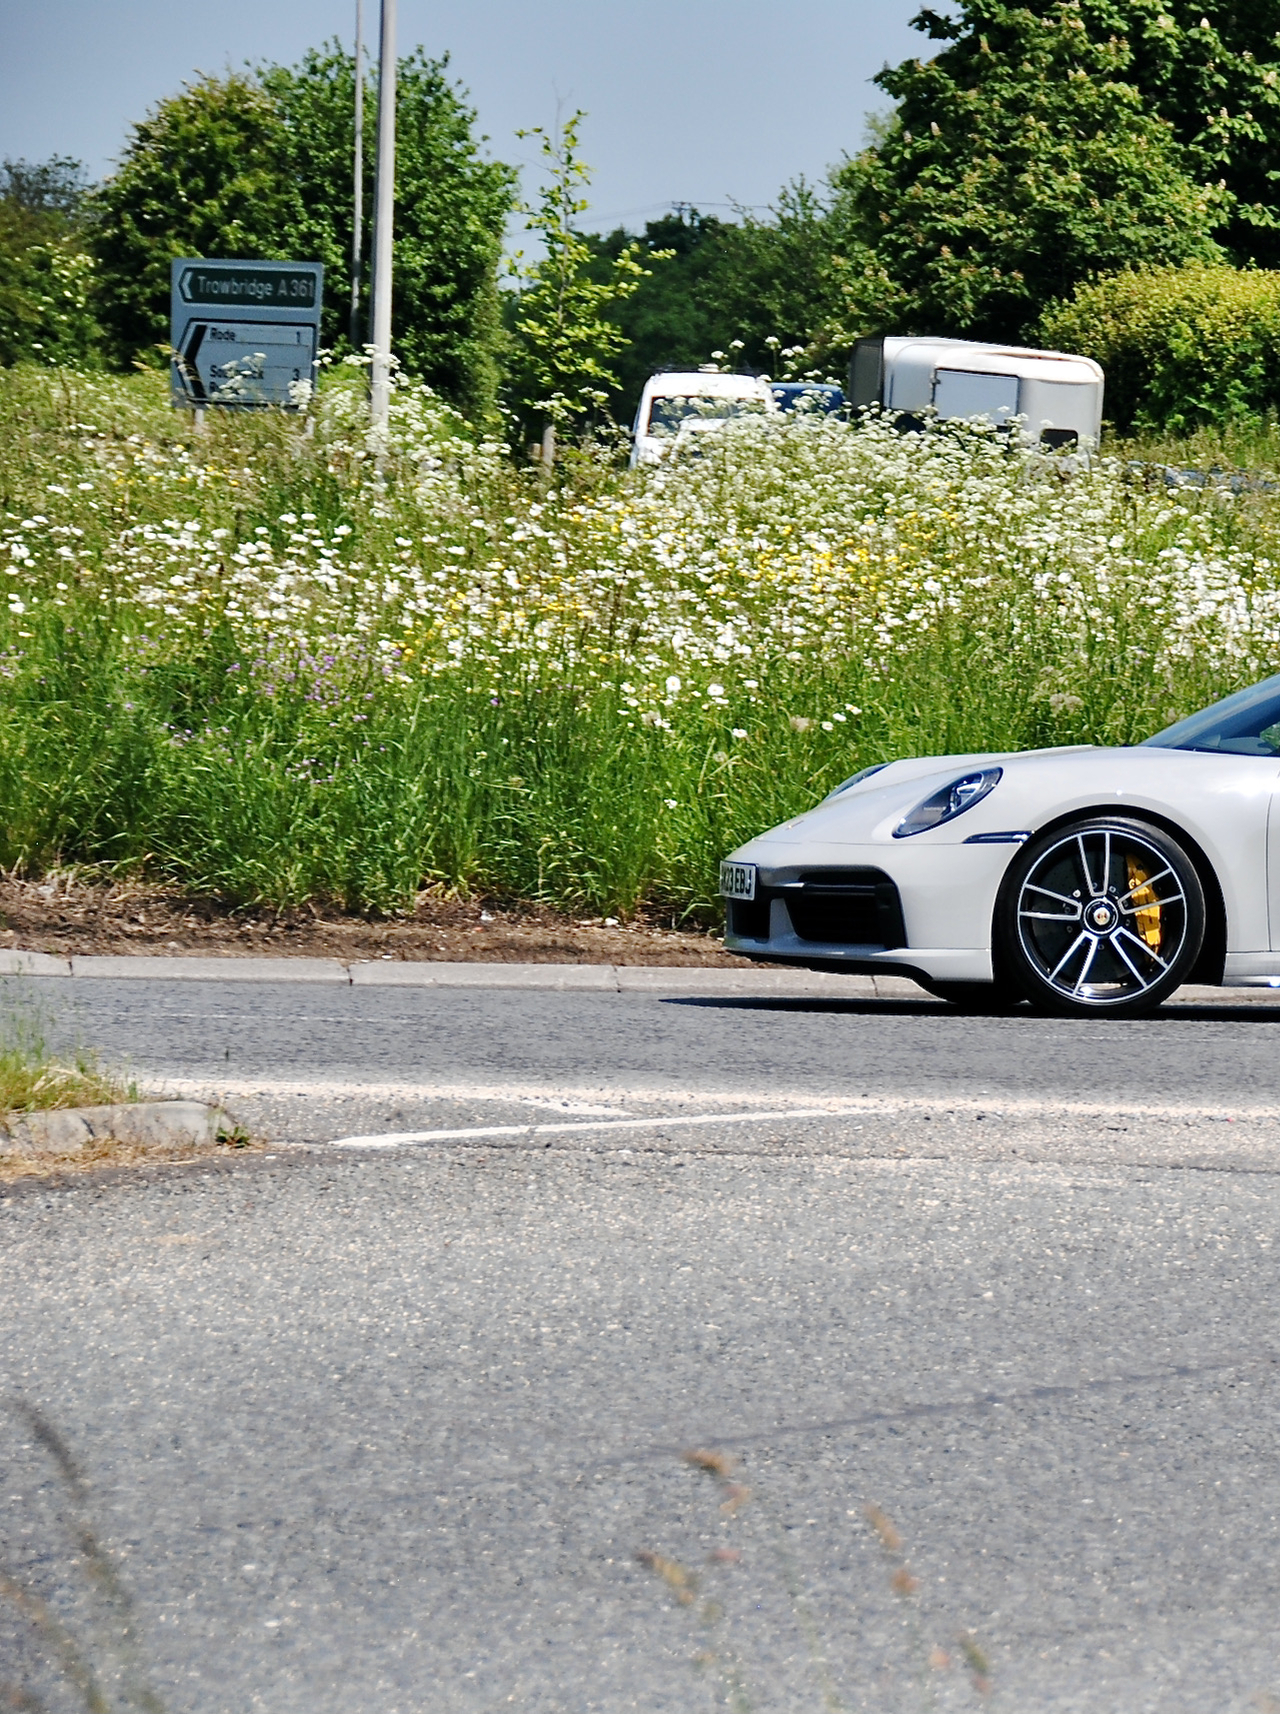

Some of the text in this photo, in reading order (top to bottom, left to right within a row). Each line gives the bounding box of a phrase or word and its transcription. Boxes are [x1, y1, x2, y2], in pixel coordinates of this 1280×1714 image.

[197, 275, 273, 300] Trowbridge
[210, 327, 236, 342] Rode
[292, 368, 300, 382] 3
[735, 868, 752, 894] EBJ
